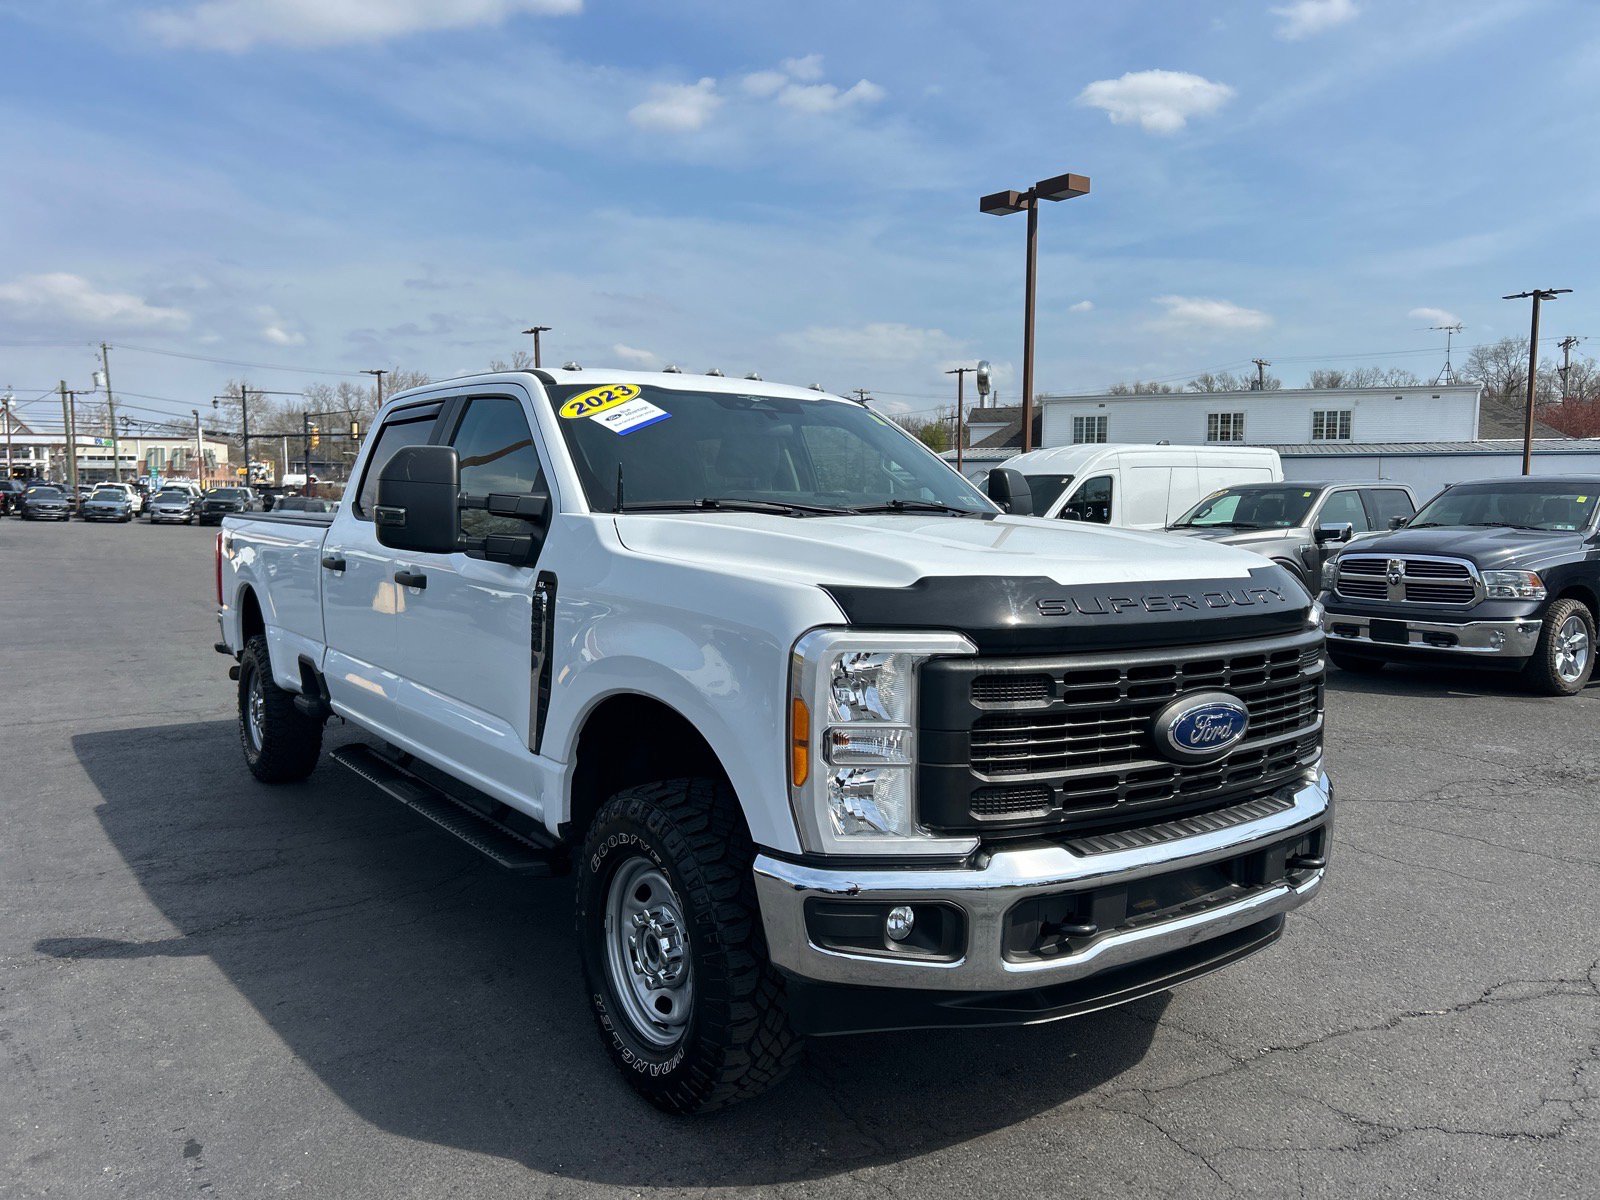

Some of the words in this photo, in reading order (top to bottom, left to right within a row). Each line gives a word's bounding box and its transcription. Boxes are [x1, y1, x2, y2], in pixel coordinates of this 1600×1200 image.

[570, 385, 633, 415] 2023
[1035, 594, 1199, 616] SUPER
[1202, 587, 1285, 608] DUTY
[1190, 713, 1234, 744] Ford
[593, 993, 685, 1077] WRANGLER
